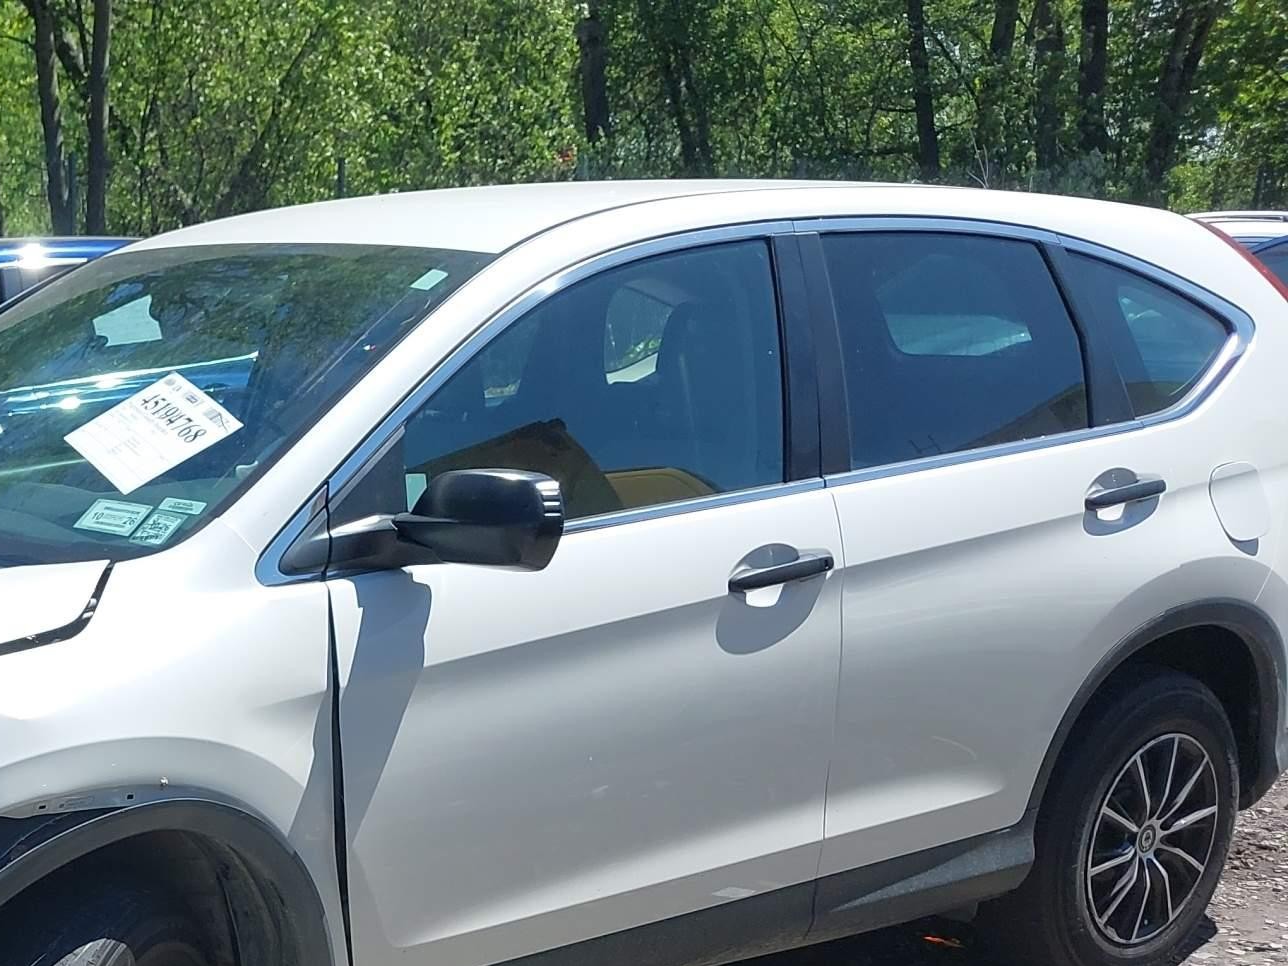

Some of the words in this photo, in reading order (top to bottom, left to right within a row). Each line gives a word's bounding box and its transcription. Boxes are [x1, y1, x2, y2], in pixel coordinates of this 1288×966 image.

[141, 395, 207, 443] 45194768
[92, 511, 105, 521] 10
[122, 516, 136, 526] 26
